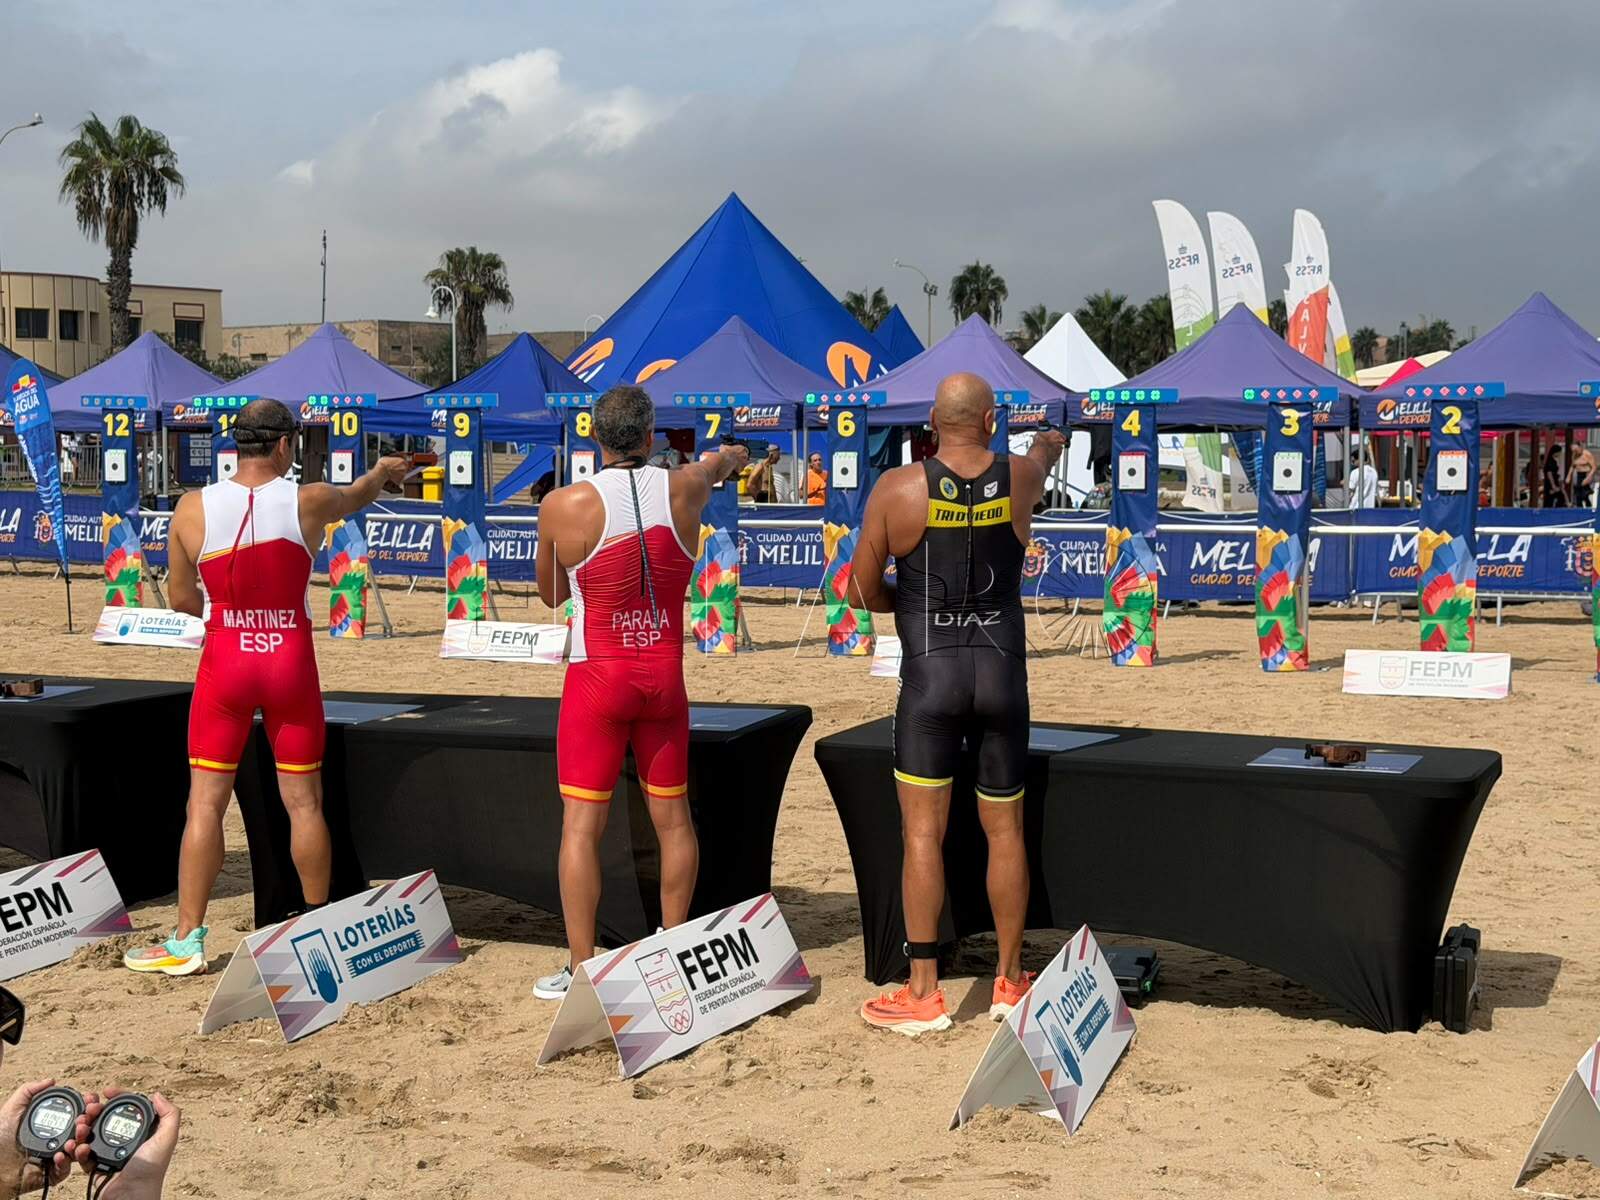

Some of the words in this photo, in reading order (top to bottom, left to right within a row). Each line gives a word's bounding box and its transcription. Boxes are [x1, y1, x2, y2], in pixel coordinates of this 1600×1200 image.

[14, 393, 40, 417] AGUA
[104, 412, 130, 436] 12
[330, 412, 358, 436] 10
[453, 412, 470, 438] 9
[575, 411, 592, 437] 8
[705, 413, 721, 439] 7
[837, 410, 856, 437] 6
[1121, 409, 1141, 437] 4
[1279, 408, 1299, 436] 3
[1440, 406, 1463, 434] 2
[487, 529, 517, 539] CIUDAD
[519, 529, 539, 539] AUT
[756, 533, 793, 543] CIUDAD
[1059, 540, 1099, 551] CIUDAD
[1190, 573, 1233, 586] CIUDAD
[1476, 564, 1525, 578] EPORTE
[140, 616, 188, 627] LOTERÍAS
[223, 608, 298, 629] MARTINEZ
[240, 632, 284, 653] ESP
[491, 630, 540, 646] FEPM
[623, 631, 661, 648] ESP
[1410, 660, 1473, 678] FEPM
[33, 919, 68, 937] ESPAÑOLA
[334, 903, 416, 952] LOTERÍAS
[4, 938, 43, 957] PENTATLÓN
[42, 927, 78, 943] MODERNO
[356, 955, 374, 969] CON
[374, 952, 384, 962] EL
[384, 937, 416, 959] DEPORTE
[676, 927, 760, 991] FEPM
[694, 981, 730, 1003] FEDERACIÓN
[729, 970, 757, 989] ESPAÑOLA
[699, 1004, 709, 1015] DE
[708, 992, 740, 1011] PENTATLÓN
[739, 979, 767, 998] MODERNO
[1056, 966, 1098, 1026] LOTERÍAS
